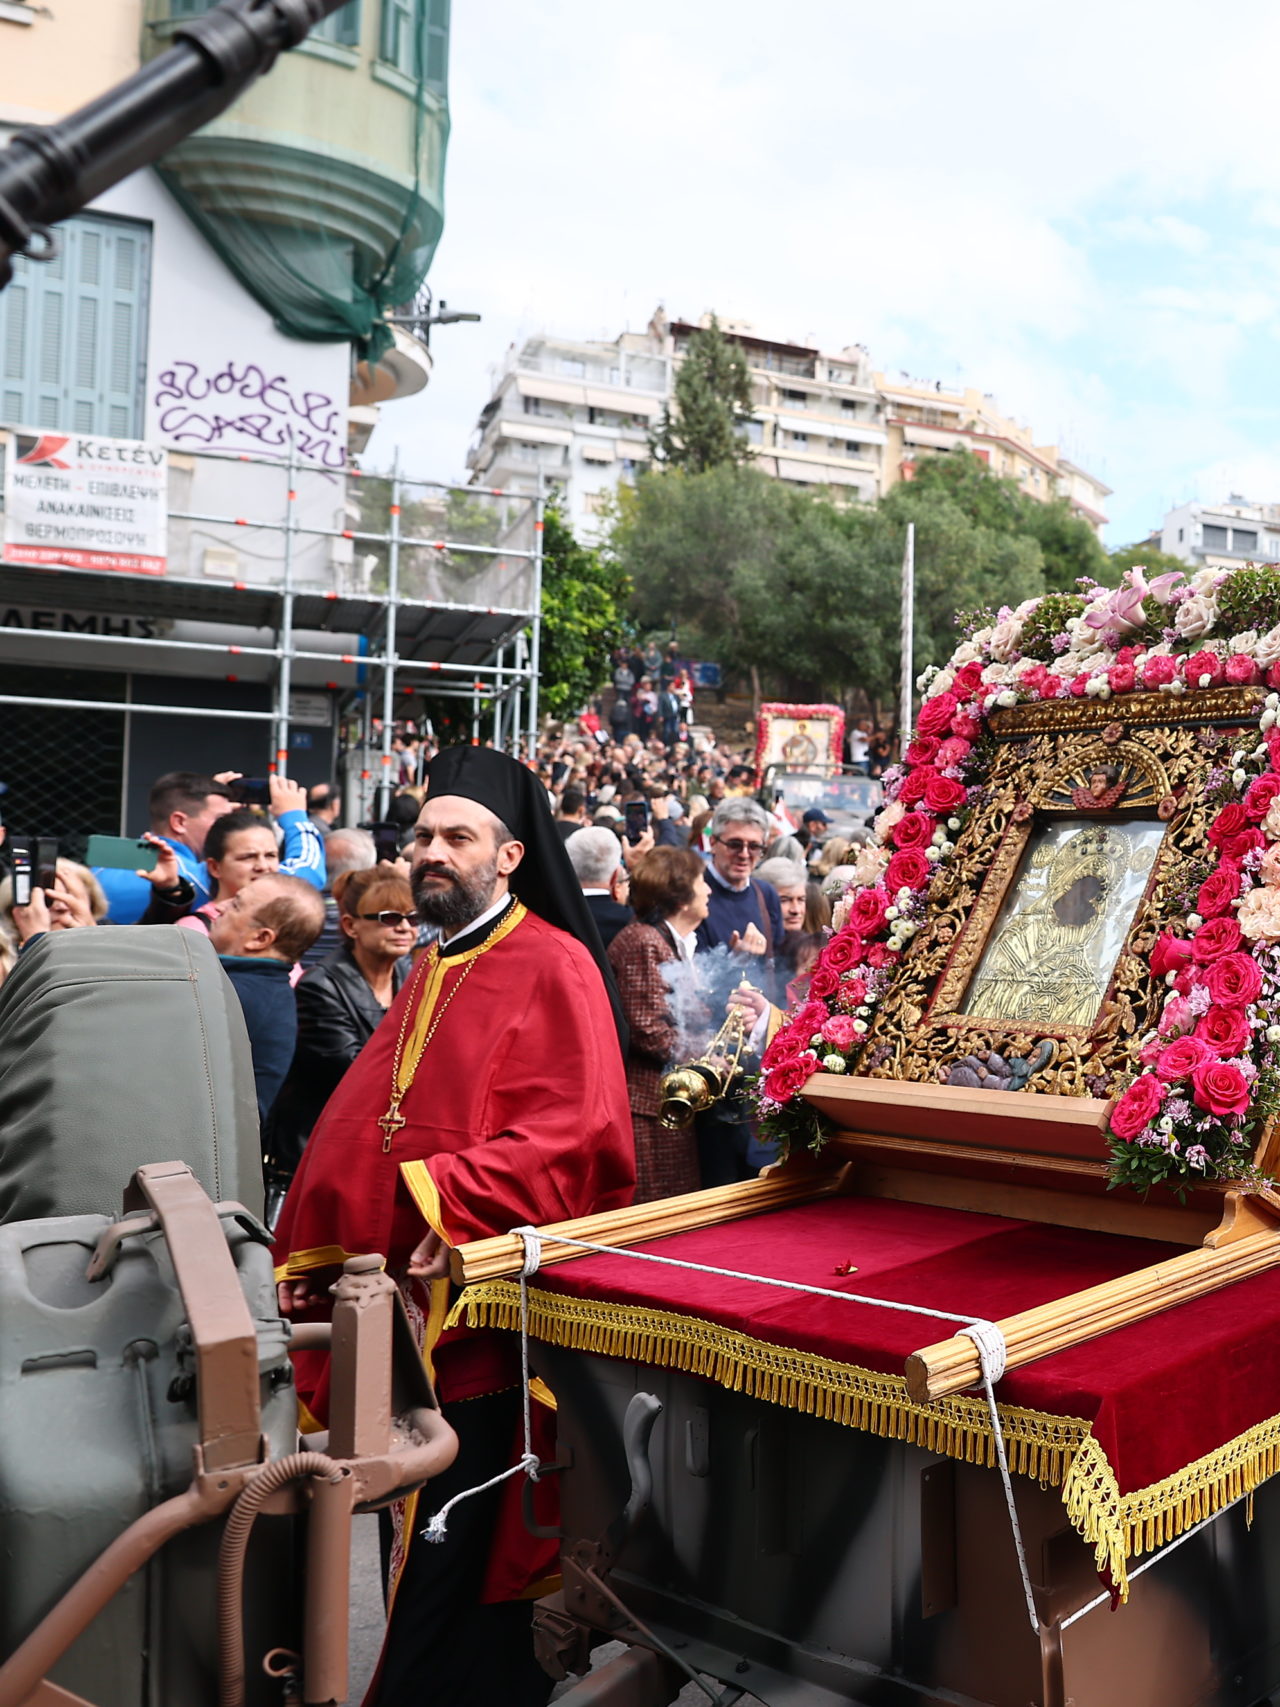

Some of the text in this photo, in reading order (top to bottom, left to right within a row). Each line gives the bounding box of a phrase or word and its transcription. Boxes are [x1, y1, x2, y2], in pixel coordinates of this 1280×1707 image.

[14, 474, 71, 492] ΜΕΛΕΤΗ
[88, 481, 160, 502] ΕΠΙΒΛΕΨΗ
[36, 499, 137, 524] ΑΝΑΚΑΙΝΙΣΕΙΣ
[24, 522, 147, 547] ΘΕΡΜΟΠΡΟΣΟΨΗ
